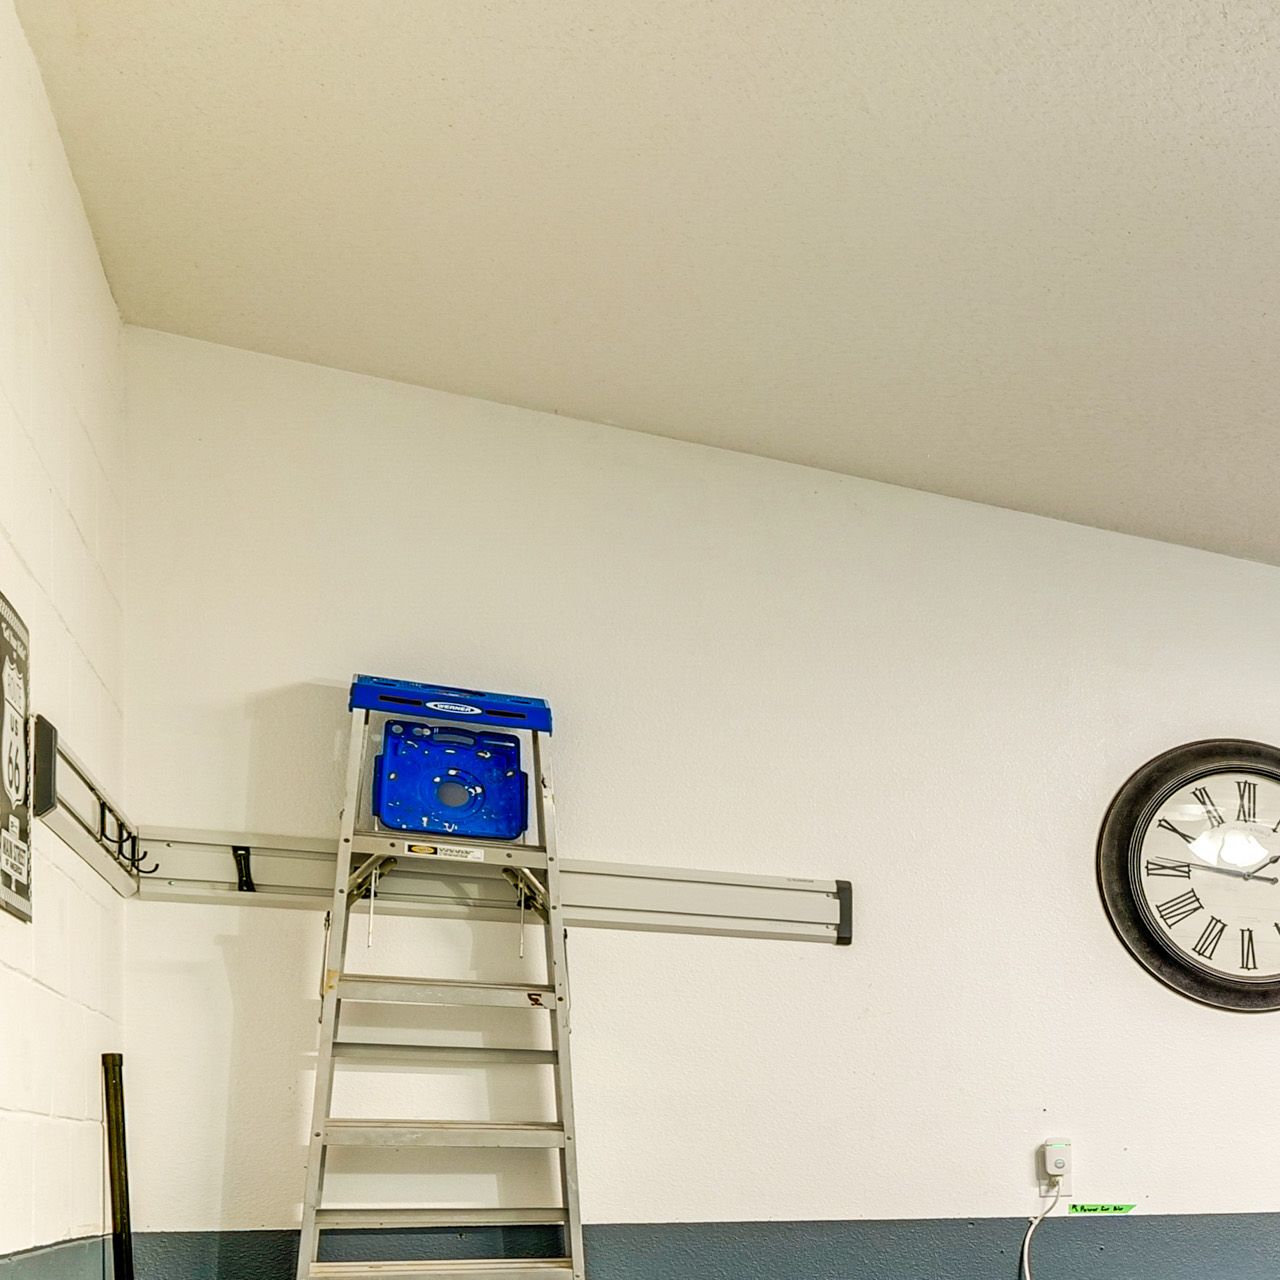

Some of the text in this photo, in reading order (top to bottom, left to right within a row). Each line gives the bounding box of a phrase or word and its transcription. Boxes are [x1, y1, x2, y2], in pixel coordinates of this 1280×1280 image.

[8, 740, 20, 795] 66
[1235, 779, 1258, 823] XII
[1145, 859, 1192, 880] IX
[1155, 887, 1205, 930] VIII
[1191, 915, 1228, 961] VII
[1239, 927, 1258, 971] VI
